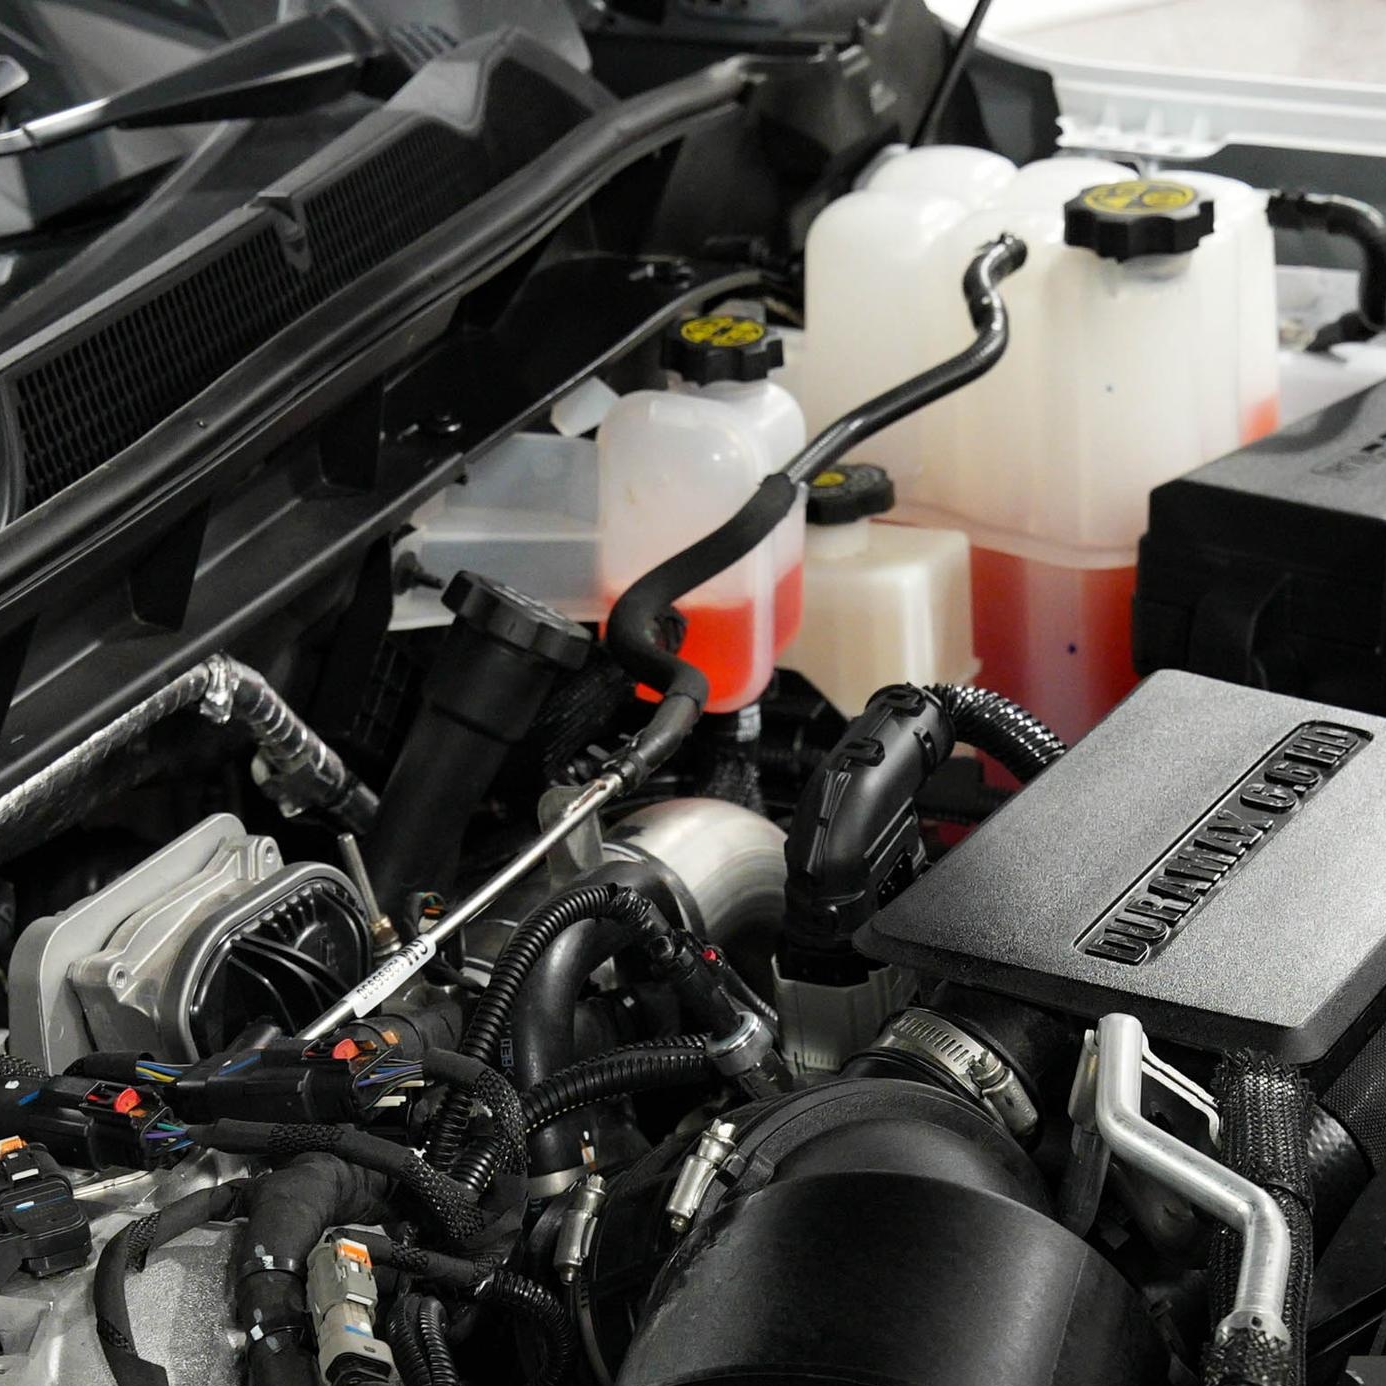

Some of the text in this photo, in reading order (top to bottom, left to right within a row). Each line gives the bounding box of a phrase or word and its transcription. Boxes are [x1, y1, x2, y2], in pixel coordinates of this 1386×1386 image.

[1084, 727, 1360, 966] DURAMAX 6.6 HD
[393, 939, 428, 966] GM
